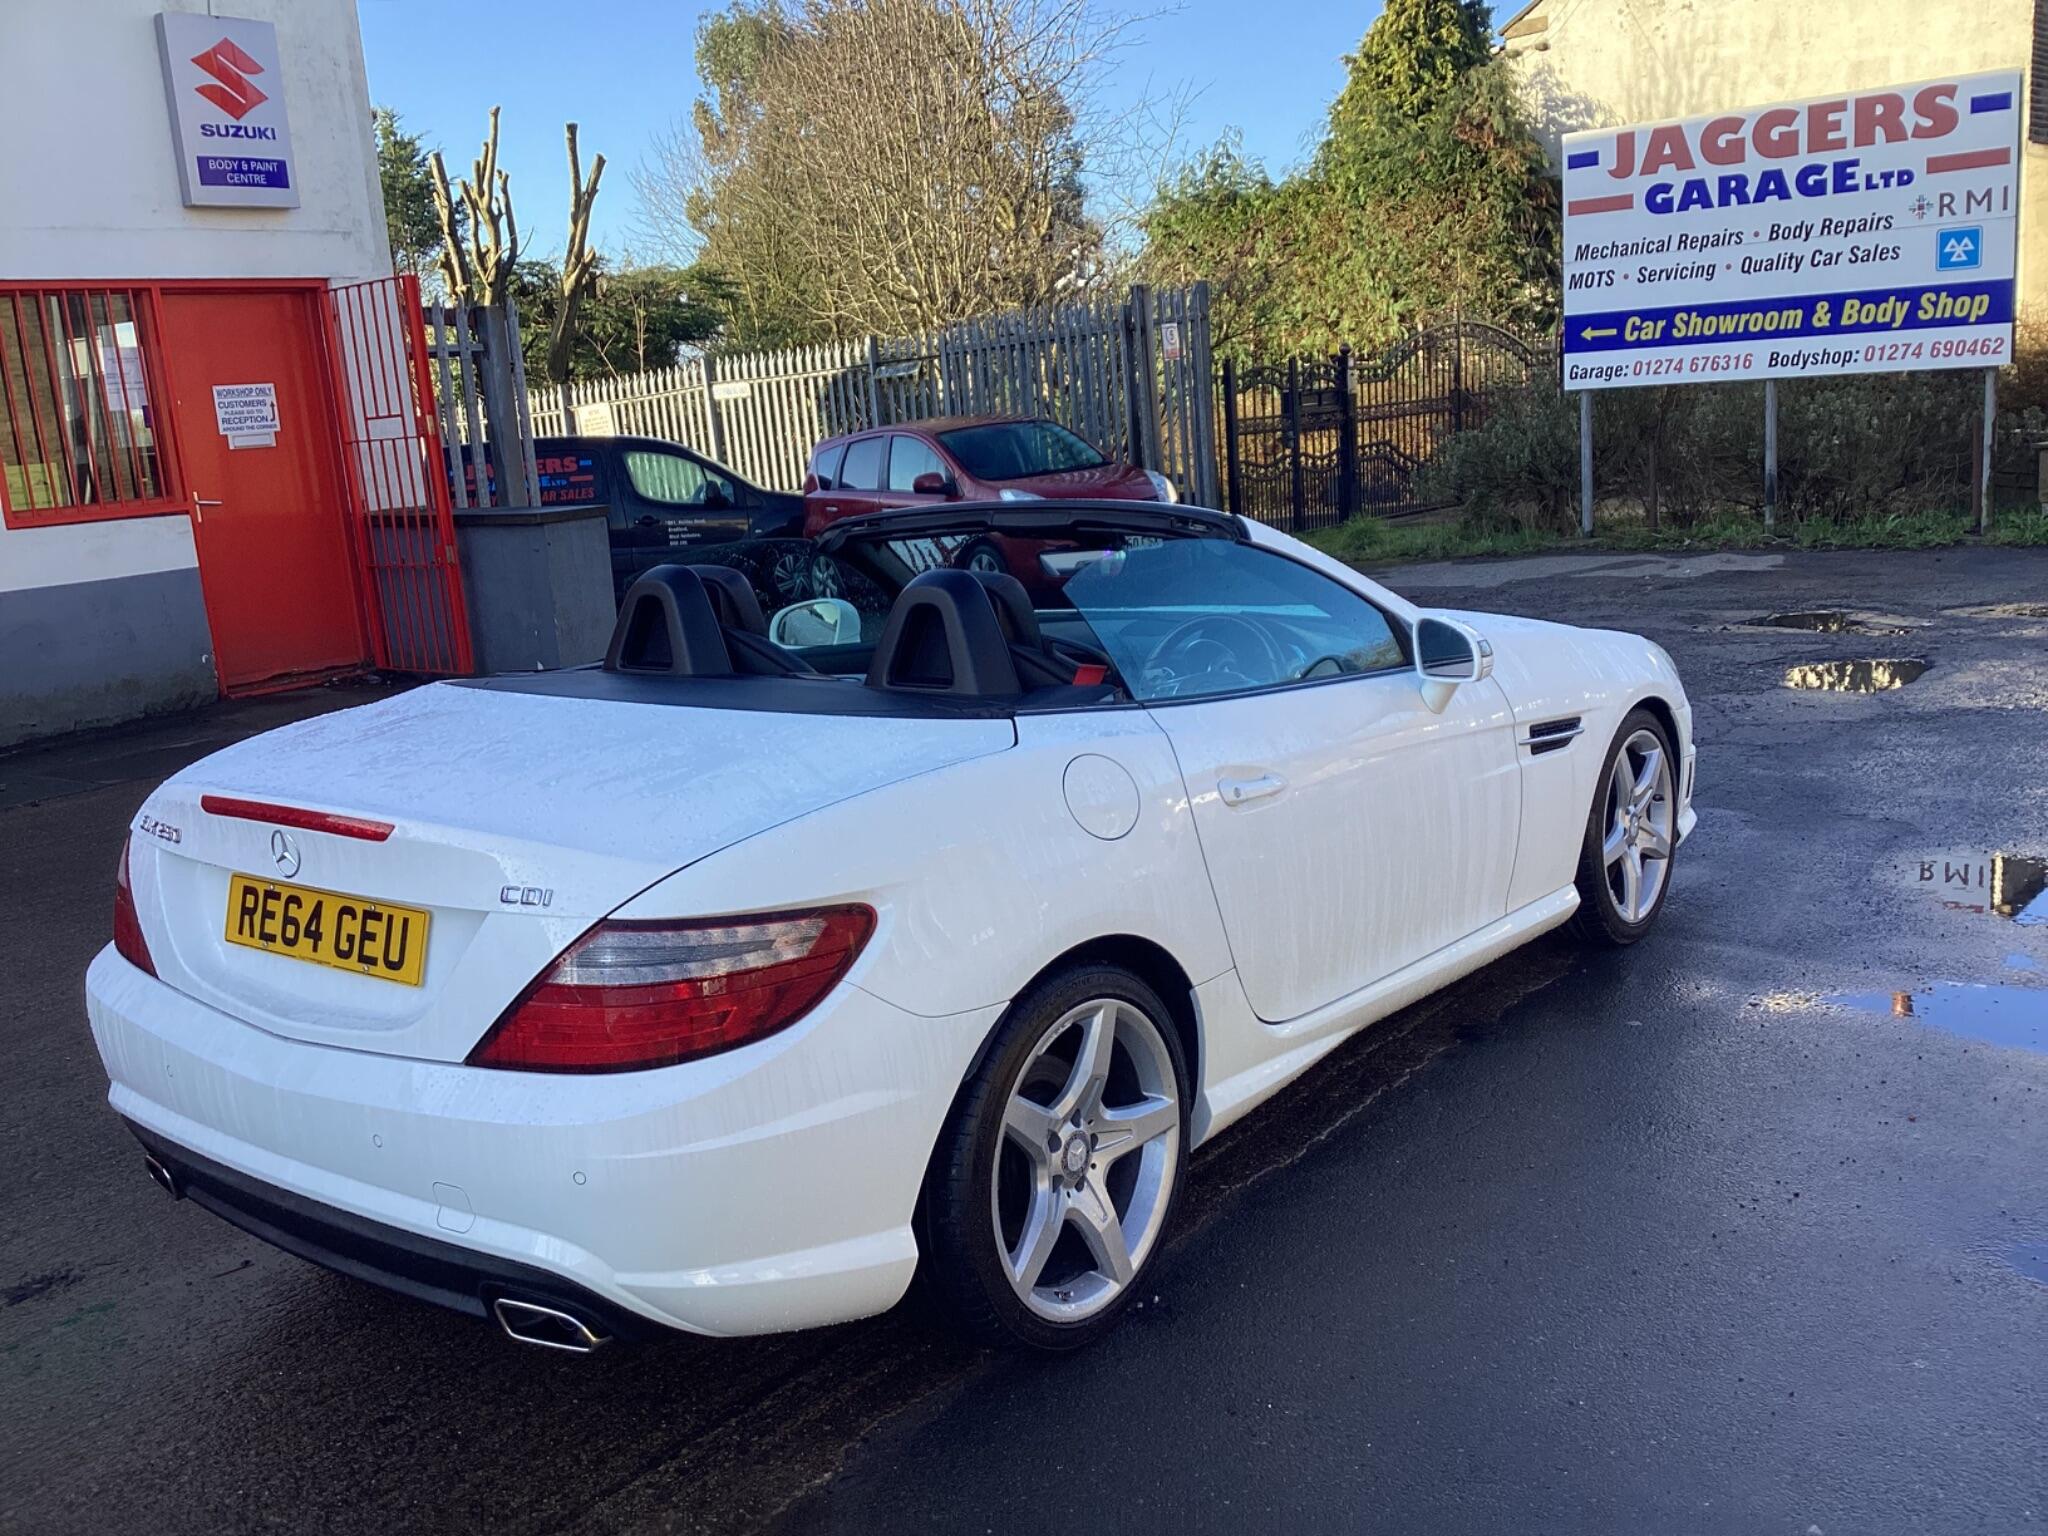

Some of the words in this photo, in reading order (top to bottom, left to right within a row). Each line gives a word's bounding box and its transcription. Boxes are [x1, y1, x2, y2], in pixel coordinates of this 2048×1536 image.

[200, 124, 276, 140] SUZUKI
[1607, 84, 1959, 179] JAGGERS
[208, 159, 238, 170] BODY
[241, 161, 248, 171] &
[250, 161, 278, 172] PAINT
[226, 172, 267, 184] CENTRE
[1645, 158, 1860, 215] GARAGE
[1865, 169, 1915, 190] LTD
[1938, 185, 2009, 217] RMI
[1574, 234, 1672, 261] Mechanical
[1677, 228, 1744, 251] Repairs
[1768, 220, 1814, 242] Body
[1819, 212, 1894, 238] Repairs
[1568, 269, 1615, 290] MOTS
[1636, 261, 1717, 282] Servicing
[1741, 252, 1805, 274] Quality
[1810, 248, 1843, 268] Car
[1848, 244, 1901, 264] Sales
[1624, 316, 1666, 342] Car
[1672, 308, 1804, 338] Showroom
[1811, 301, 1832, 328] &
[1840, 295, 1911, 328] Body
[1917, 292, 1990, 322] Shop
[1569, 363, 1630, 382] Garage:
[1632, 357, 1684, 376] 01274
[1689, 352, 1754, 373] 676316
[1768, 348, 1860, 370] Bodyshop:
[1864, 341, 1924, 362] 01274
[1929, 336, 2005, 358] 690462
[216, 387, 253, 398] WORKSHOP
[254, 386, 272, 396] ONLY
[217, 399, 267, 409] CUSTOMERS
[221, 415, 268, 424] RECEPTION
[560, 486, 595, 501] SALES
[499, 885, 554, 907] CDI
[237, 885, 324, 953] RE64
[333, 905, 409, 971] GEU
